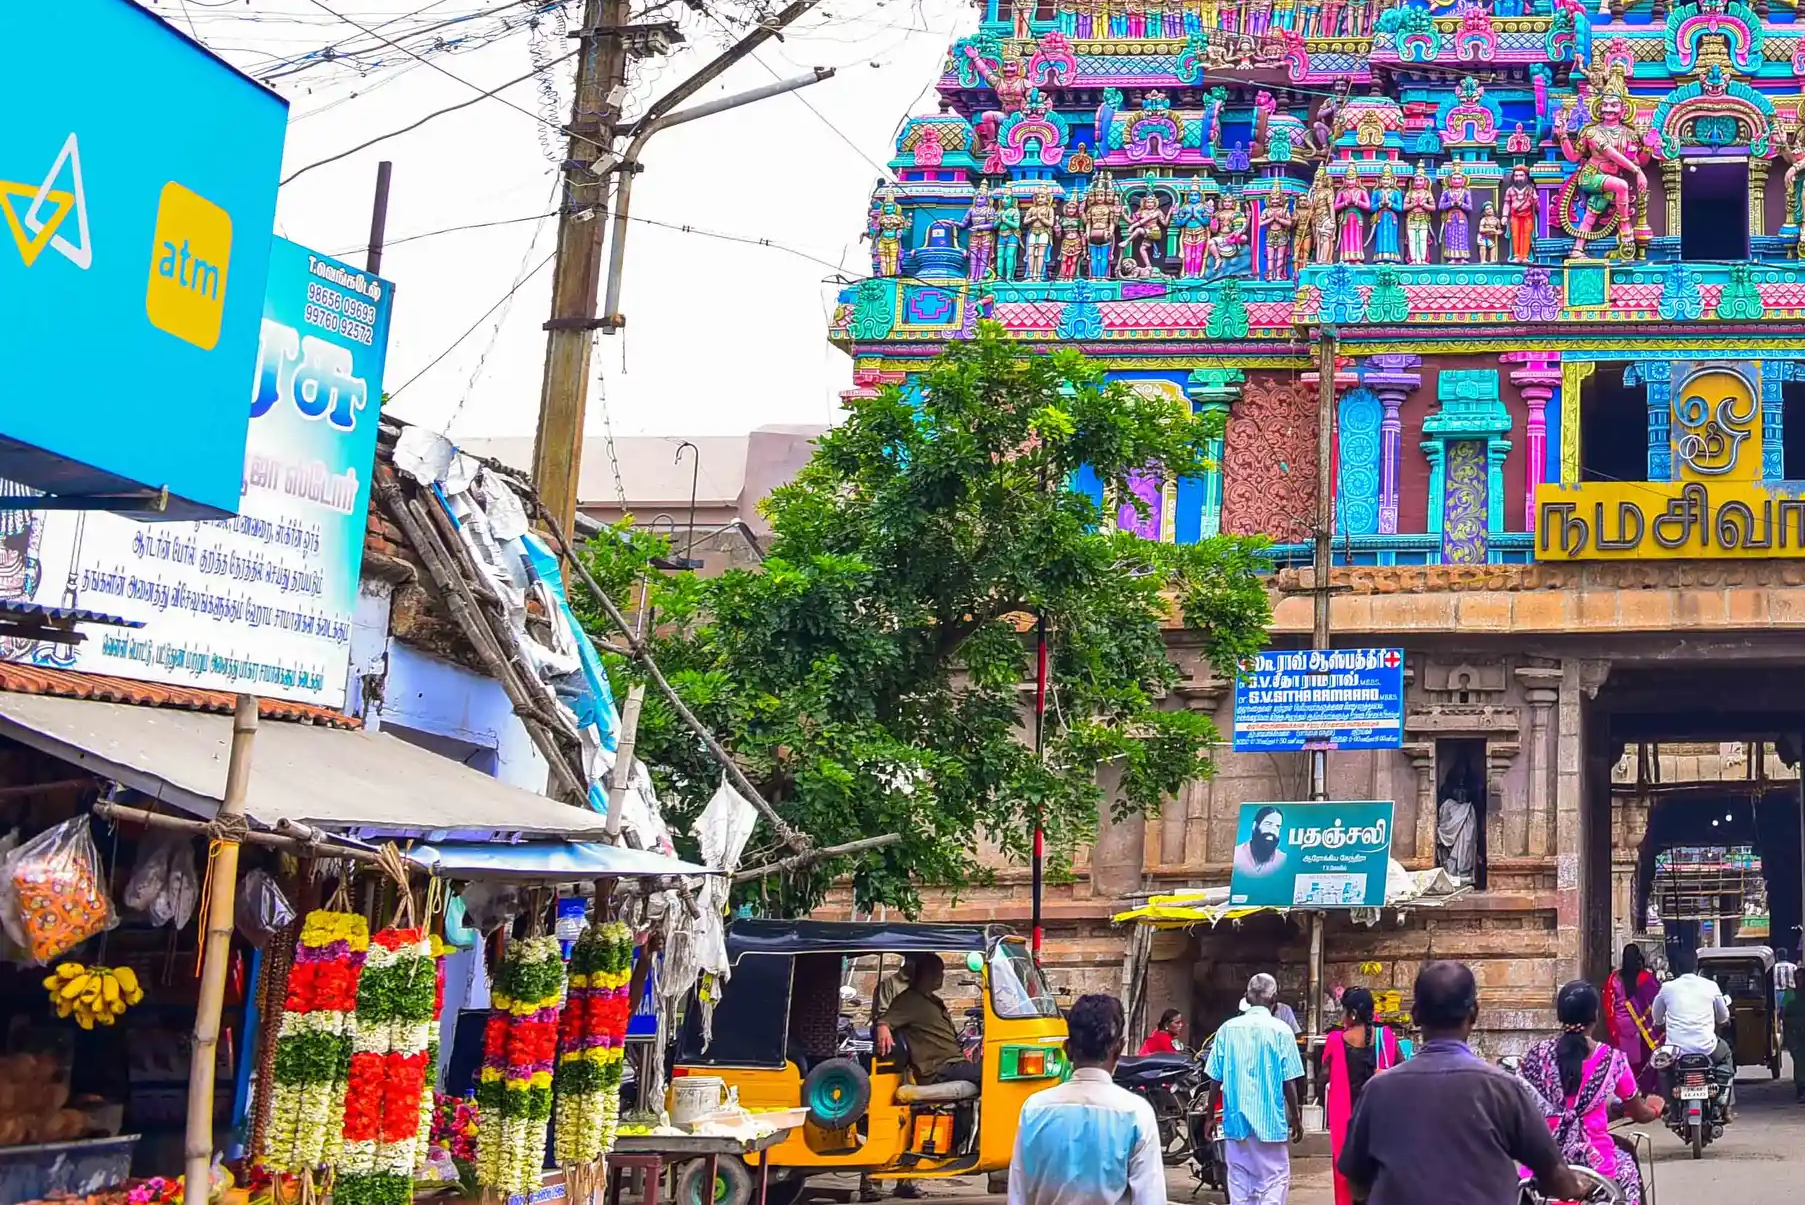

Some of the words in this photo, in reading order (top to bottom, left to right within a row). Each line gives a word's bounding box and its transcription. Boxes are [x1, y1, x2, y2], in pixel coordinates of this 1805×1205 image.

[158, 236, 221, 302] atm
[308, 284, 341, 310] 98656
[343, 294, 376, 324] 09693
[305, 305, 339, 331] 99760
[340, 320, 372, 344] 92572
[1309, 648, 1386, 672] ஆஸ்பத்திரி
[1288, 818, 1387, 851] பதஞ்சலி
